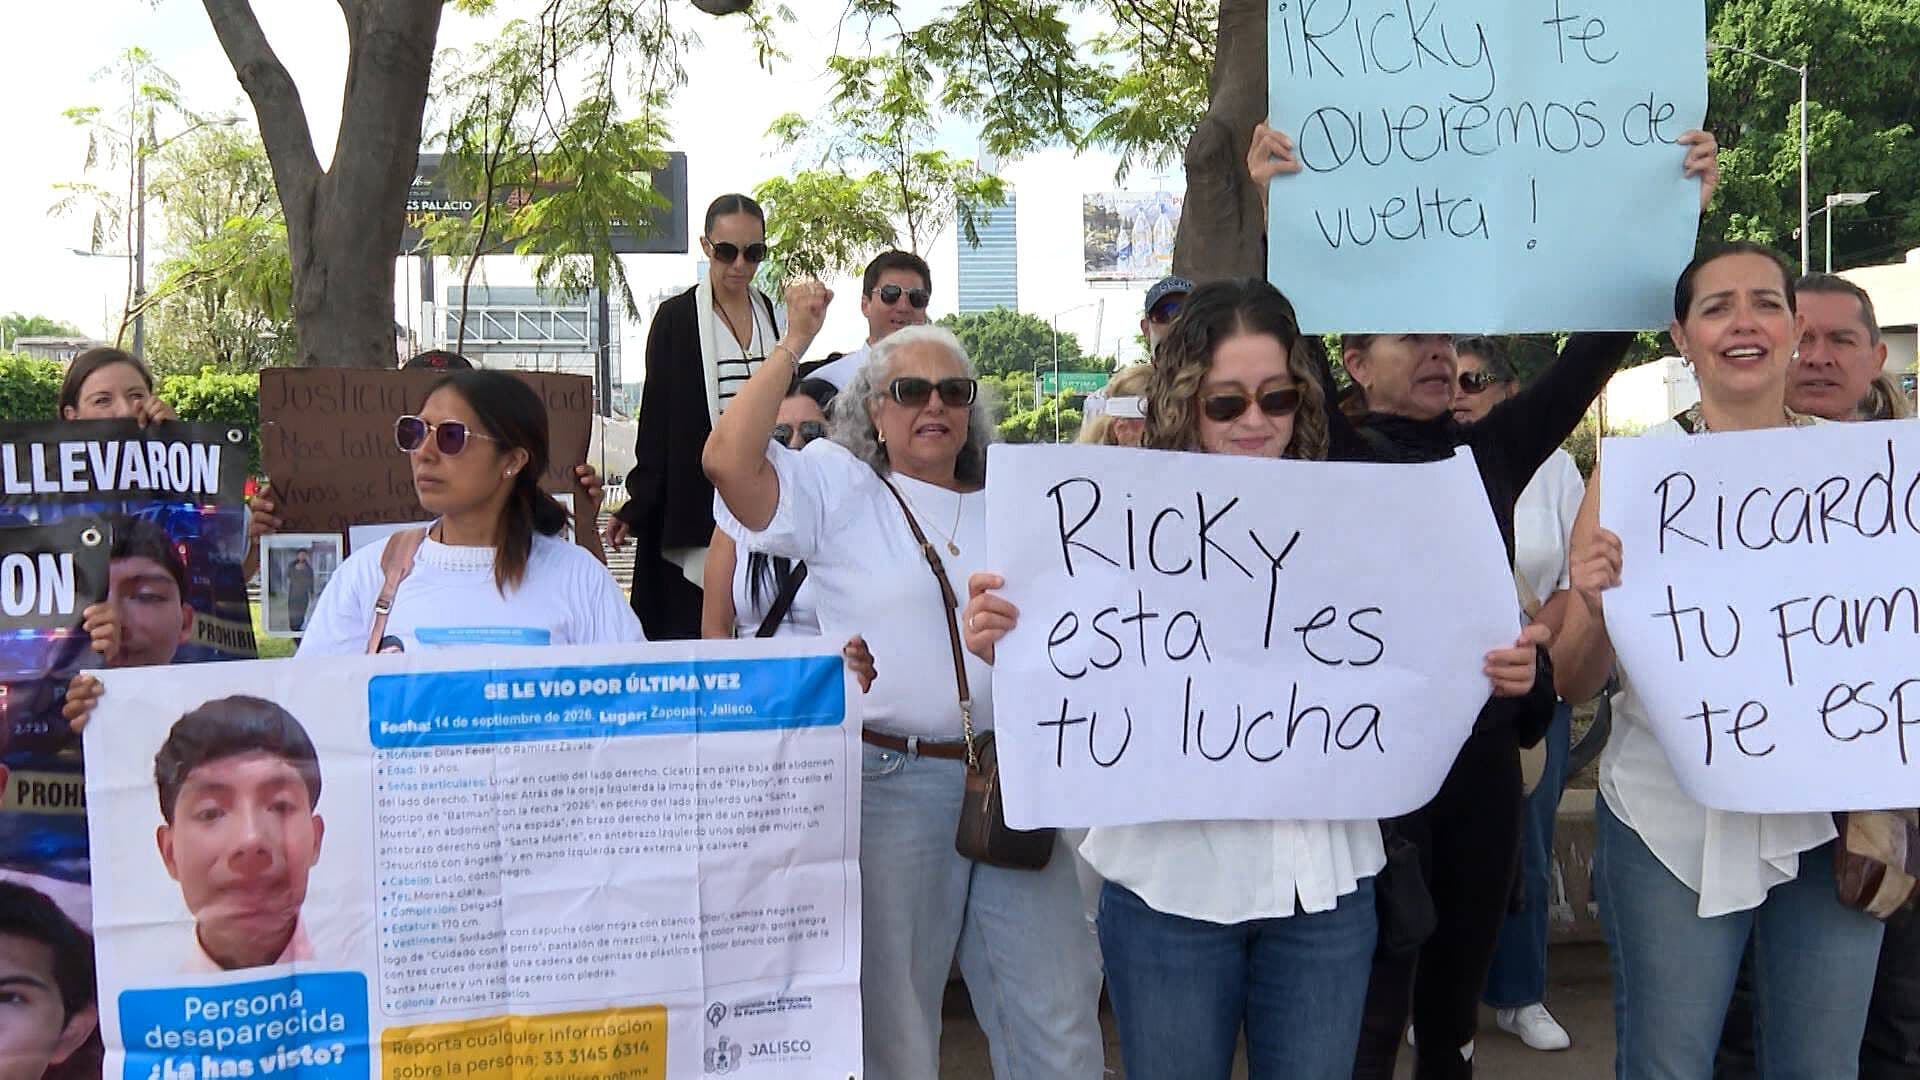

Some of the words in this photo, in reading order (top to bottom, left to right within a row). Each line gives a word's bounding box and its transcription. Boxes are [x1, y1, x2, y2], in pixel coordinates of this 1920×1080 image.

[1544, 0, 1619, 64] te
[1623, 92, 1681, 147] de
[421, 201, 473, 211] PALACIO
[1314, 185, 1489, 249] vuelta
[2, 440, 221, 494] LLEVARON
[1047, 589, 1211, 679] esta
[1294, 605, 1385, 666] es
[1651, 585, 1741, 662] tu
[484, 682, 508, 701] SE
[512, 682, 536, 700] LE
[539, 679, 576, 698] VIO
[579, 677, 621, 696] POR
[626, 672, 700, 694] ÚLTIMA
[702, 672, 741, 691] VEZ
[435, 717, 449, 730] 14
[453, 715, 468, 729] de
[472, 712, 542, 731] septiembre
[545, 711, 560, 725] de
[600, 710, 647, 726] Lugar:
[1037, 697, 1132, 768] tu
[1182, 676, 1385, 763] lucha
[1684, 700, 1776, 766] te
[184, 989, 304, 1022] Persona
[144, 1007, 346, 1050] desaparecida
[392, 1038, 462, 1058] Reporta
[466, 1030, 546, 1050] cualquier
[549, 1018, 653, 1042] información
[748, 1039, 812, 1057] JALISCO
[201, 1055, 254, 1079] has
[258, 1042, 346, 1073] visto?
[393, 1061, 442, 1080] sobre
[446, 1059, 463, 1076] la
[543, 1050, 565, 1066] 33
[569, 1045, 607, 1063] 3145
[612, 1039, 650, 1061] 6314
